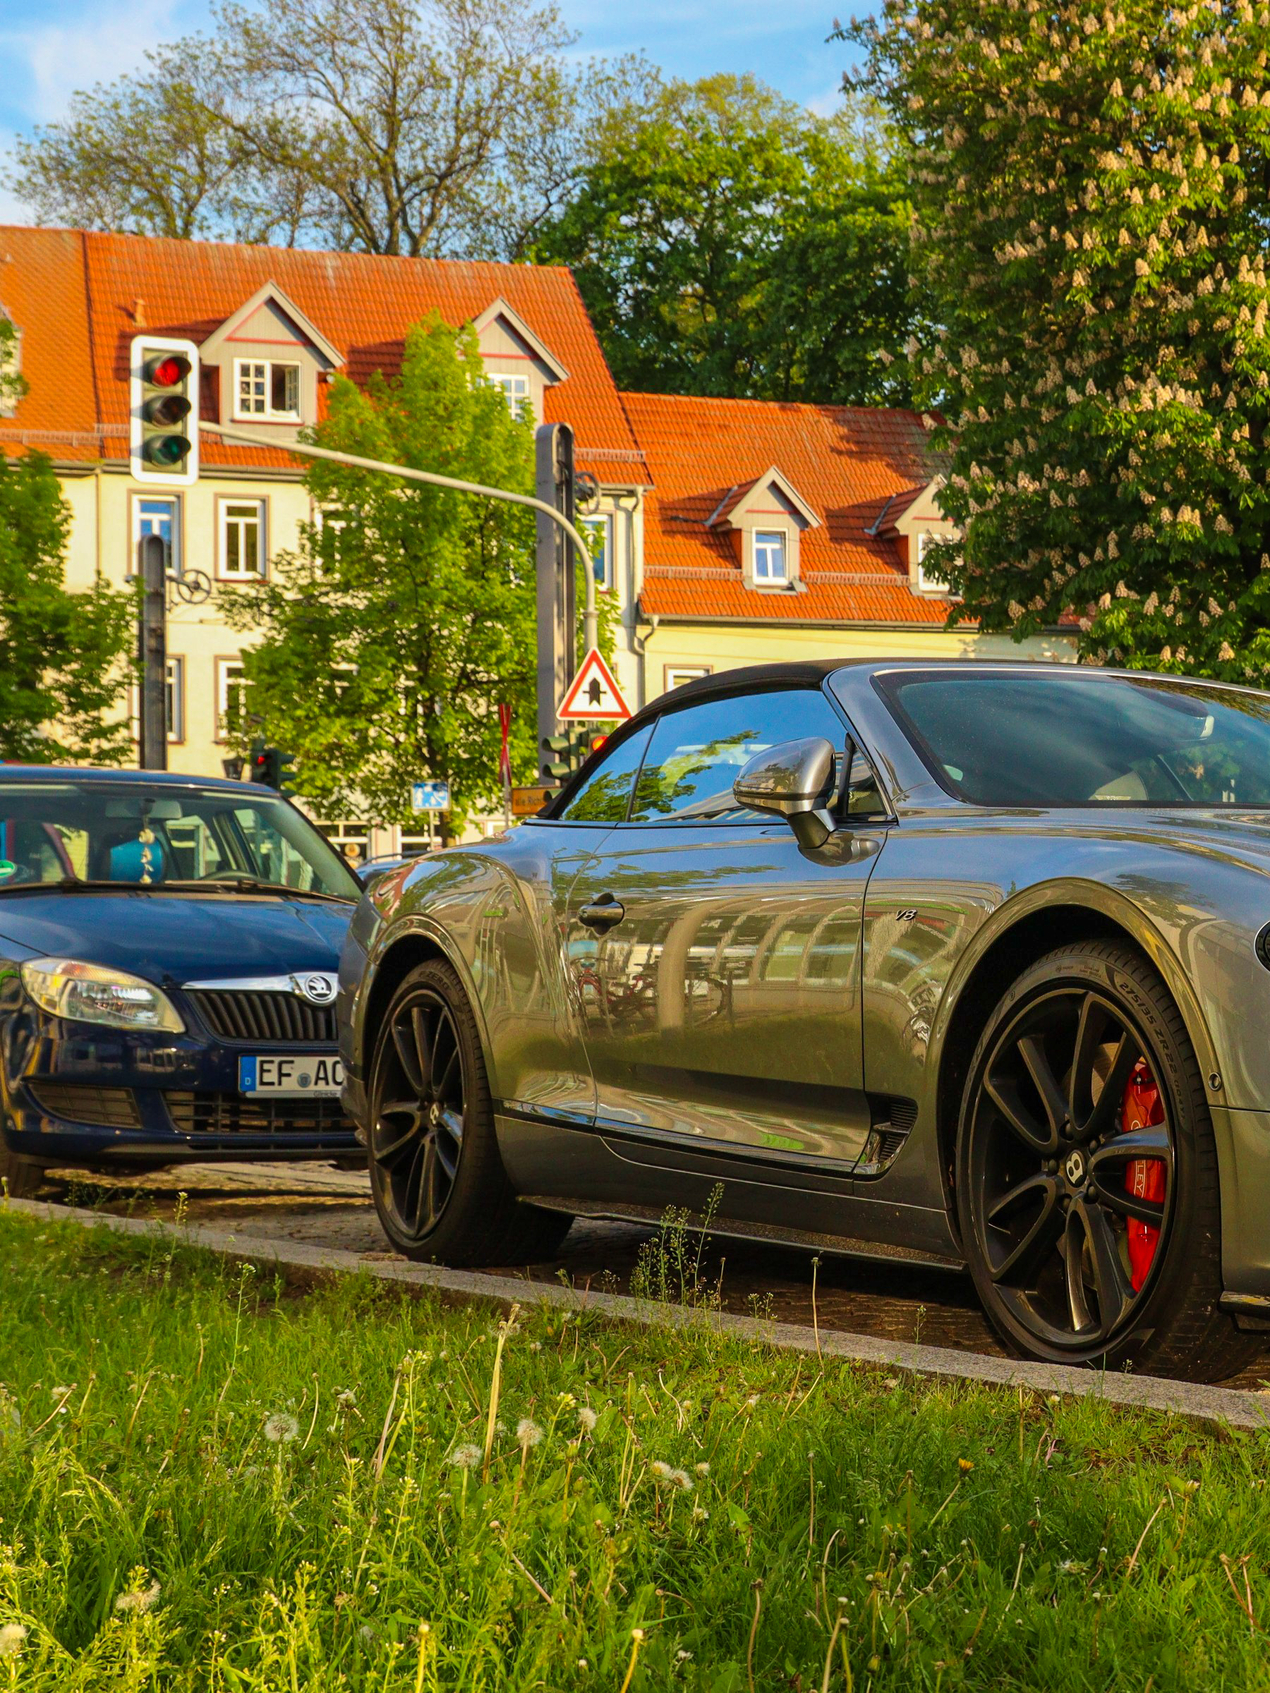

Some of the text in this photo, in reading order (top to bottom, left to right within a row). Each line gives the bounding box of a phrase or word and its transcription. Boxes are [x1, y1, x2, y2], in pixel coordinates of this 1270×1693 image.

[895, 908, 918, 921] V8
[1119, 982, 1157, 1025] 275/35
[1153, 1028, 1178, 1074] ZR22
[259, 1060, 295, 1086] EF
